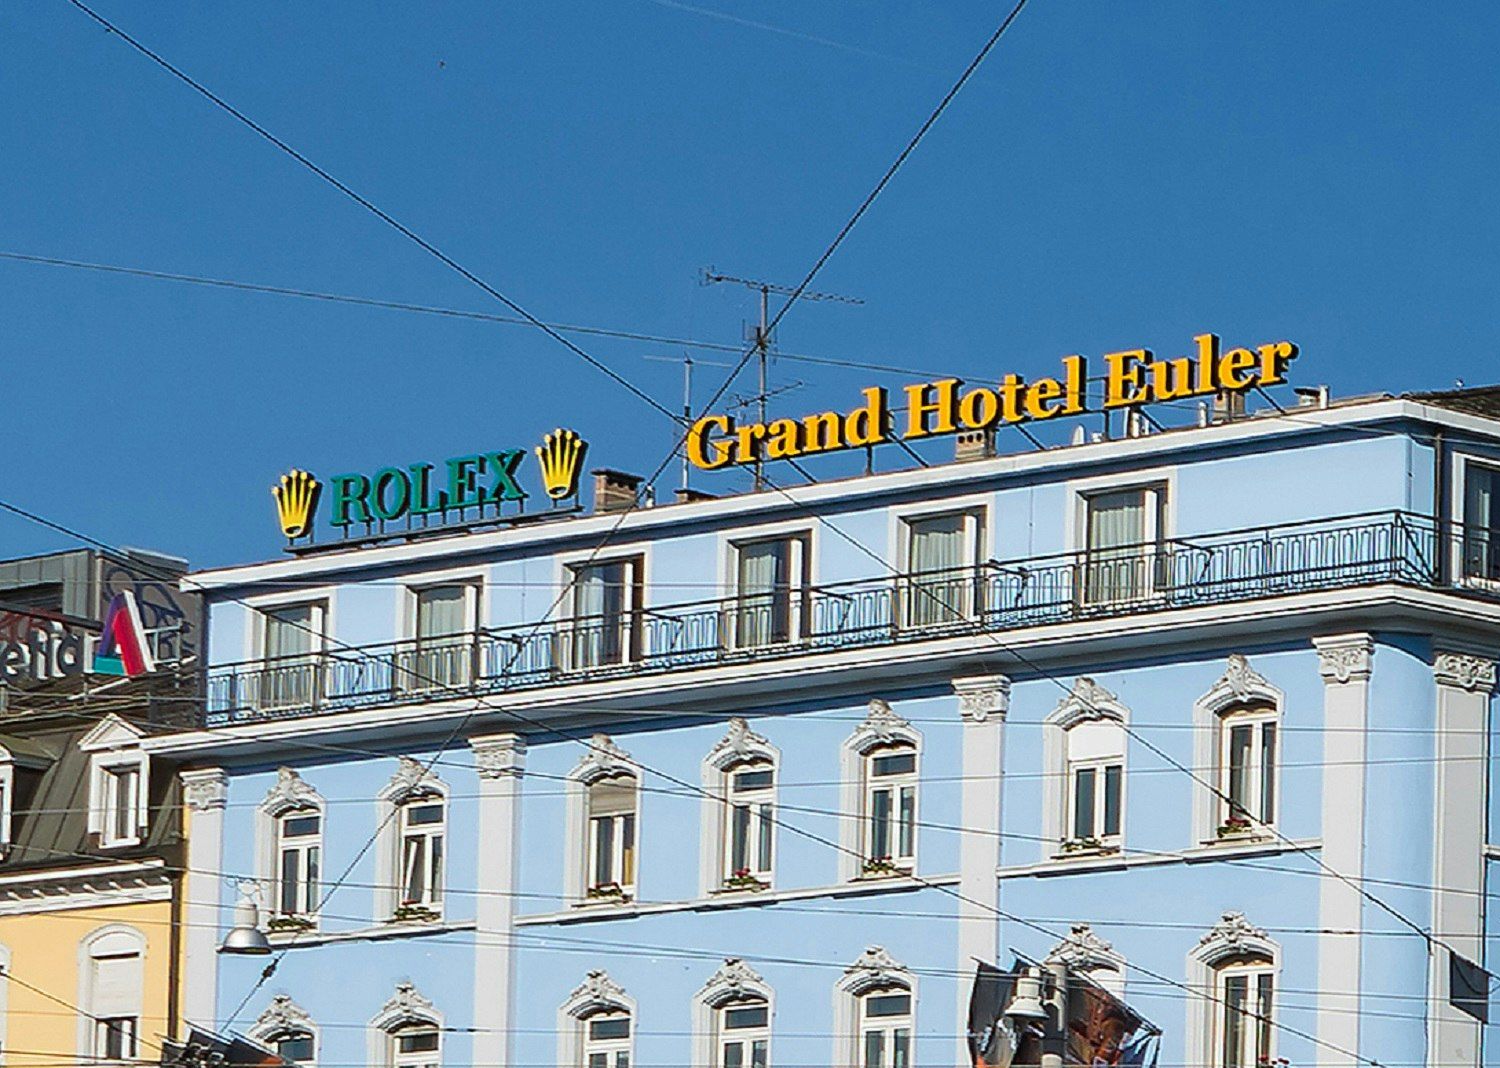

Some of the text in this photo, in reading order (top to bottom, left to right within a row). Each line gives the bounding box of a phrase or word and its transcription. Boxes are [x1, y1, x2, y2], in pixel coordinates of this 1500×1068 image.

[686, 333, 1298, 471] Grand Hotel Euler
[329, 448, 530, 527] ROLEX
